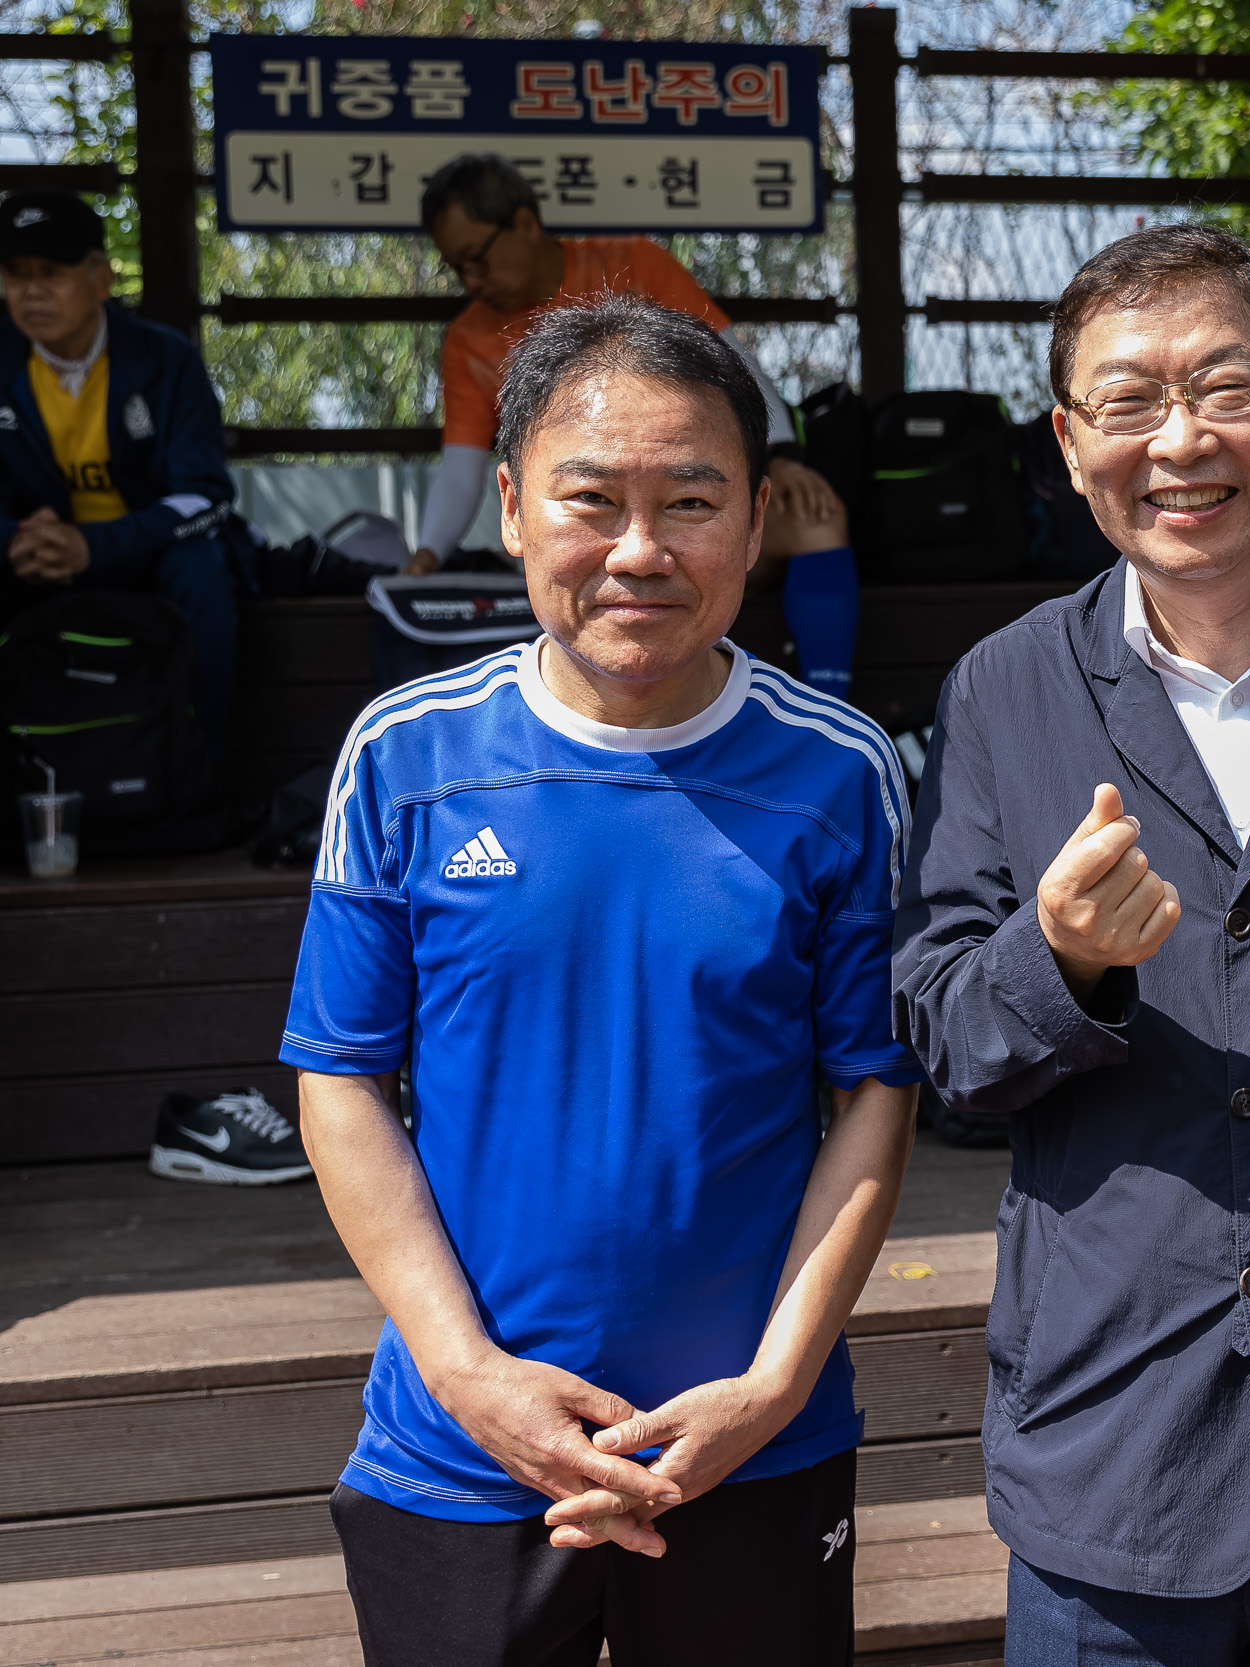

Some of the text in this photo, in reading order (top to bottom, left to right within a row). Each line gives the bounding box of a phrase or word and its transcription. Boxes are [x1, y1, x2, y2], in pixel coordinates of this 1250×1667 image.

[257, 56, 790, 127] 귀중품 도난주의
[444, 858, 517, 878] adidas
